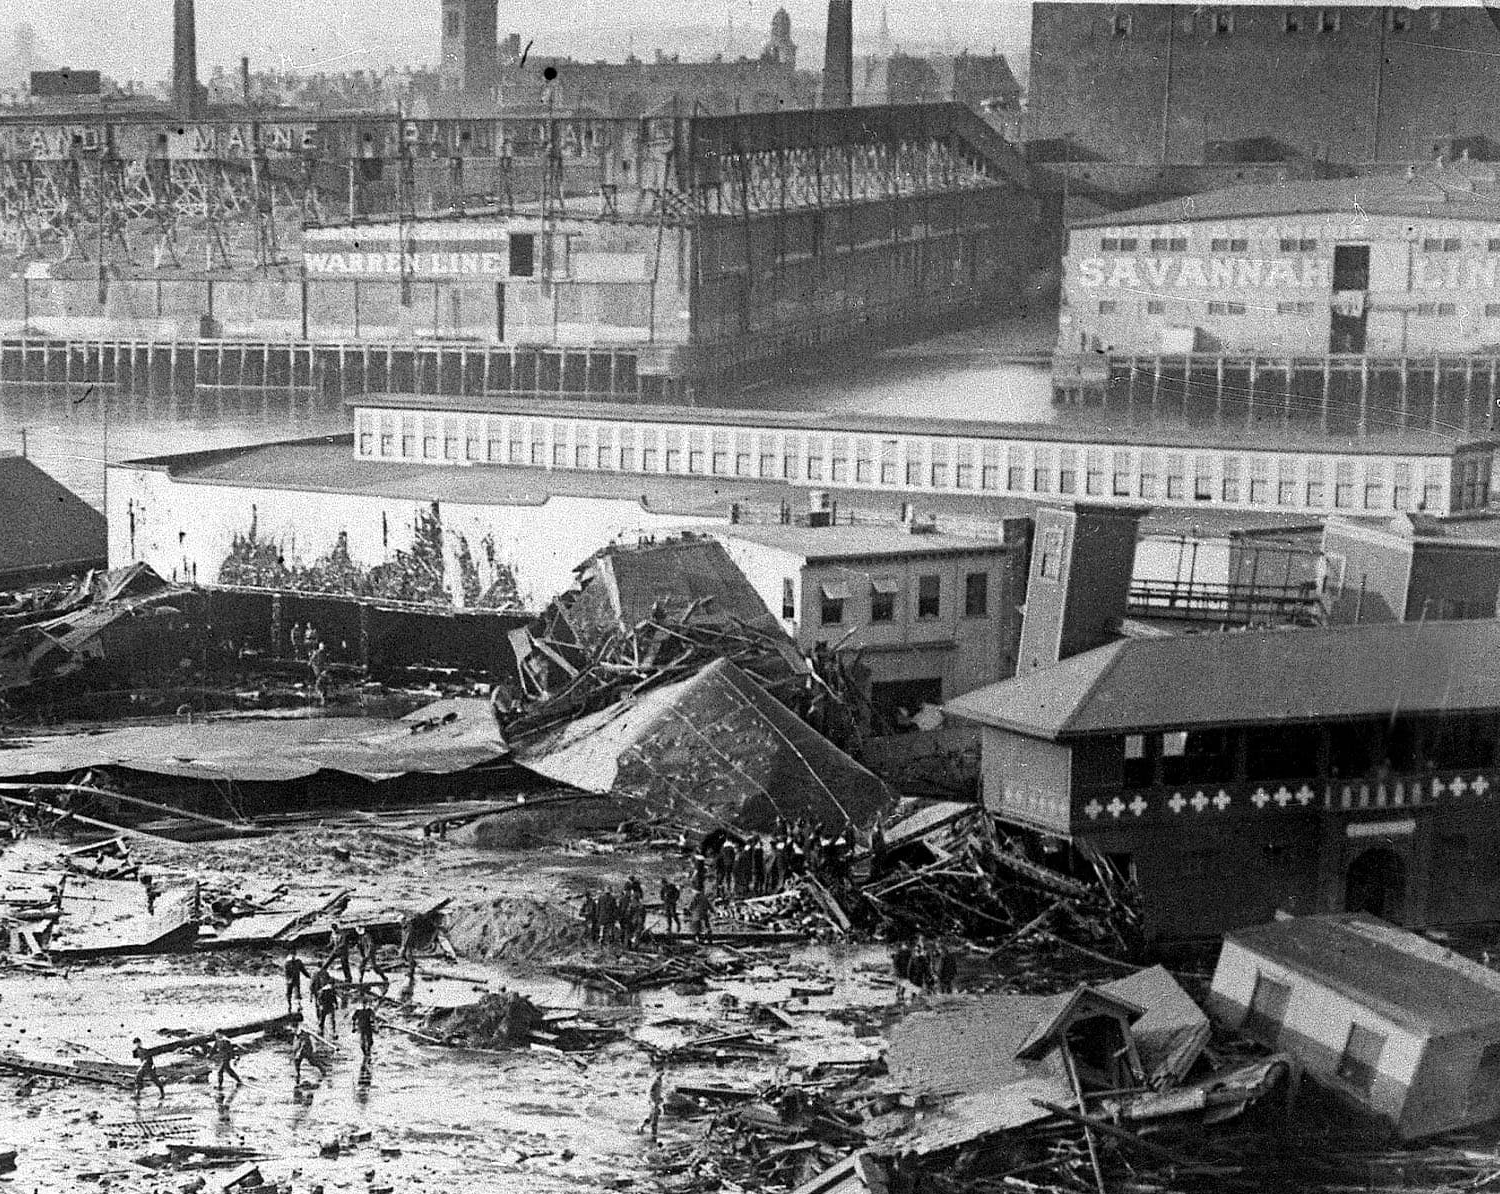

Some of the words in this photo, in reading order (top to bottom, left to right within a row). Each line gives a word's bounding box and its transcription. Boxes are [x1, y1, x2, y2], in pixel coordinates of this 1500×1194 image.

[303, 252, 420, 274] WARREN
[430, 252, 501, 275] LINE
[1079, 256, 1331, 290] SAVANNAH
